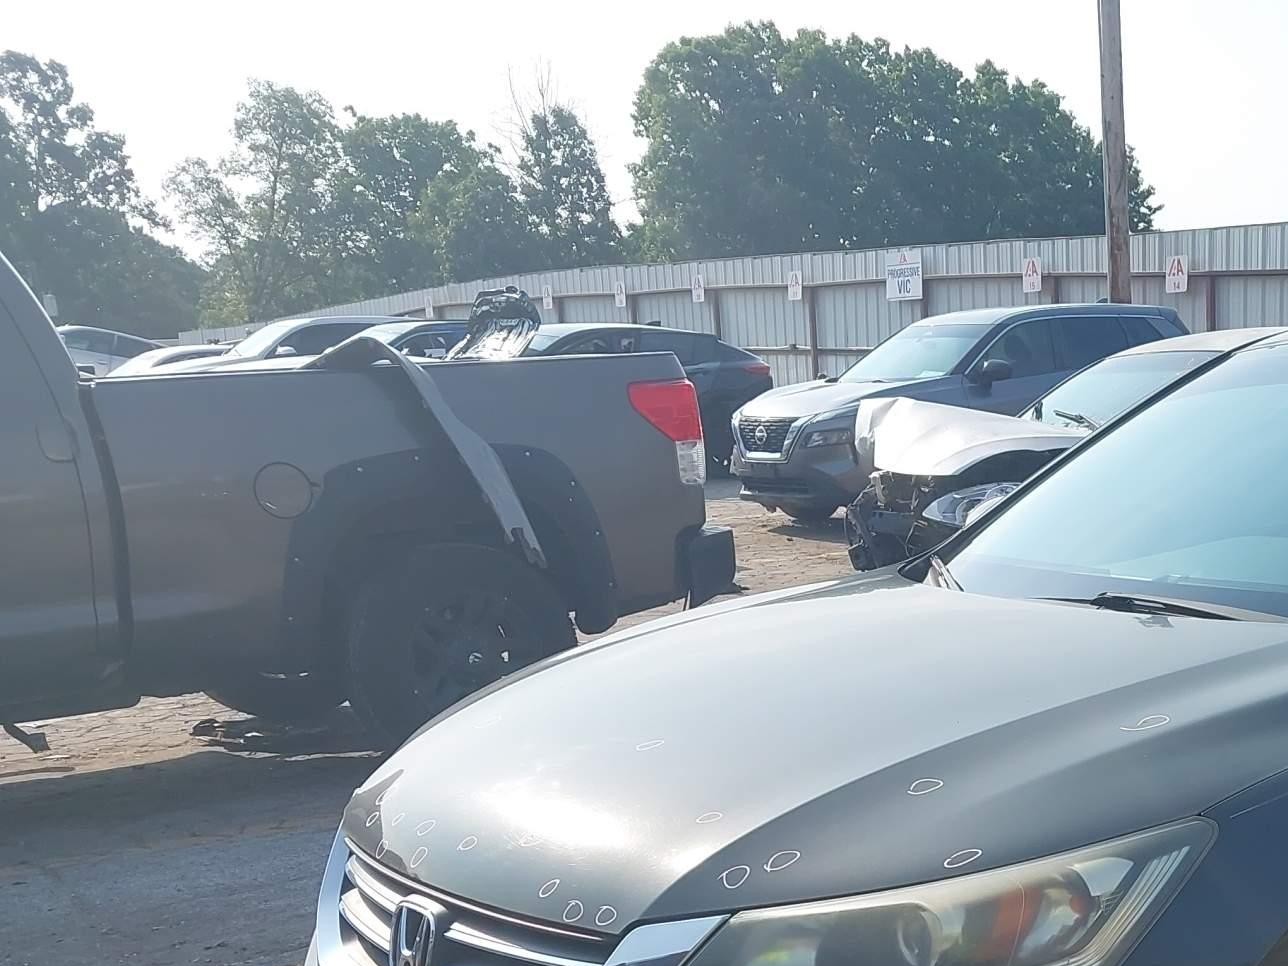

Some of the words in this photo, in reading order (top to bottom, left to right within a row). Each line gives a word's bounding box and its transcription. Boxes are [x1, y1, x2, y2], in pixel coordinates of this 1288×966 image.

[887, 266, 920, 279] PROGRESSIVE
[897, 279, 911, 294] VIC
[1173, 281, 1181, 290] 14
